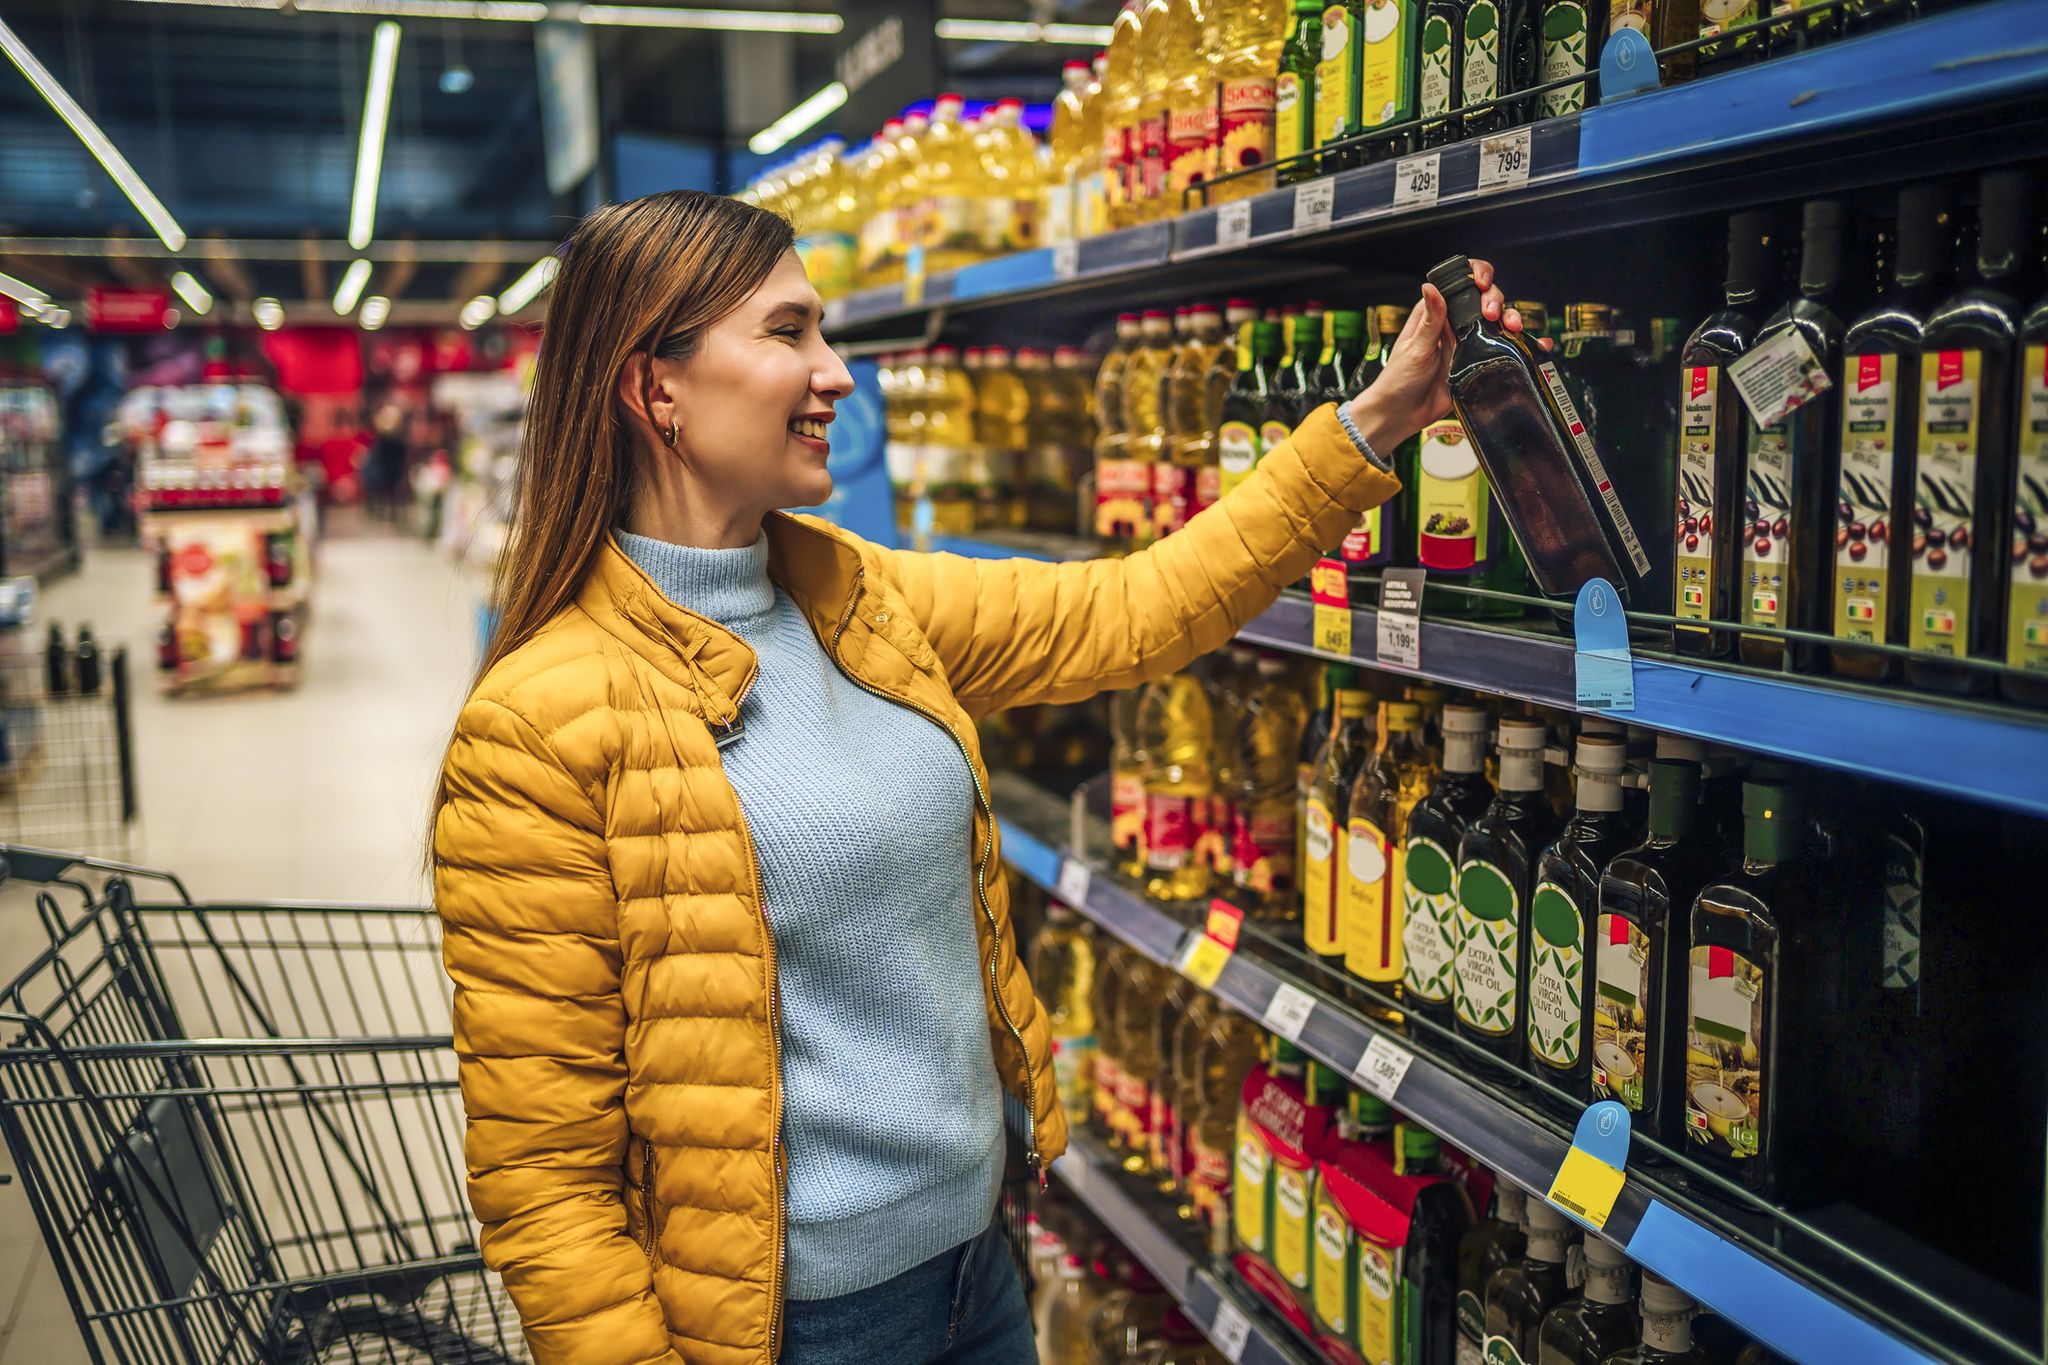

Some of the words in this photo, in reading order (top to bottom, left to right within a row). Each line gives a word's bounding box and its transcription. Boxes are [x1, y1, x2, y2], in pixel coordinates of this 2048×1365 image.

[1468, 68, 1485, 79] VIRGIN
[1469, 60, 1485, 71] EXTRA
[1549, 61, 1570, 72] EXTRA
[1479, 74, 1490, 84] OIL
[1547, 69, 1571, 80] VIRGIN
[1498, 151, 1520, 173] 799
[1411, 172, 1431, 193] 429
[1388, 632, 1410, 649] 1,199
[1468, 947, 1494, 964] EXTRA
[1466, 959, 1496, 977] VIRGIN
[1461, 967, 1484, 986] OLIVE
[1486, 978, 1502, 992] OIL
[1539, 973, 1562, 993] EXTRA
[1538, 986, 1562, 1007] VIRGIN
[1533, 995, 1553, 1015] OLIVE
[1554, 1007, 1569, 1022] OIL
